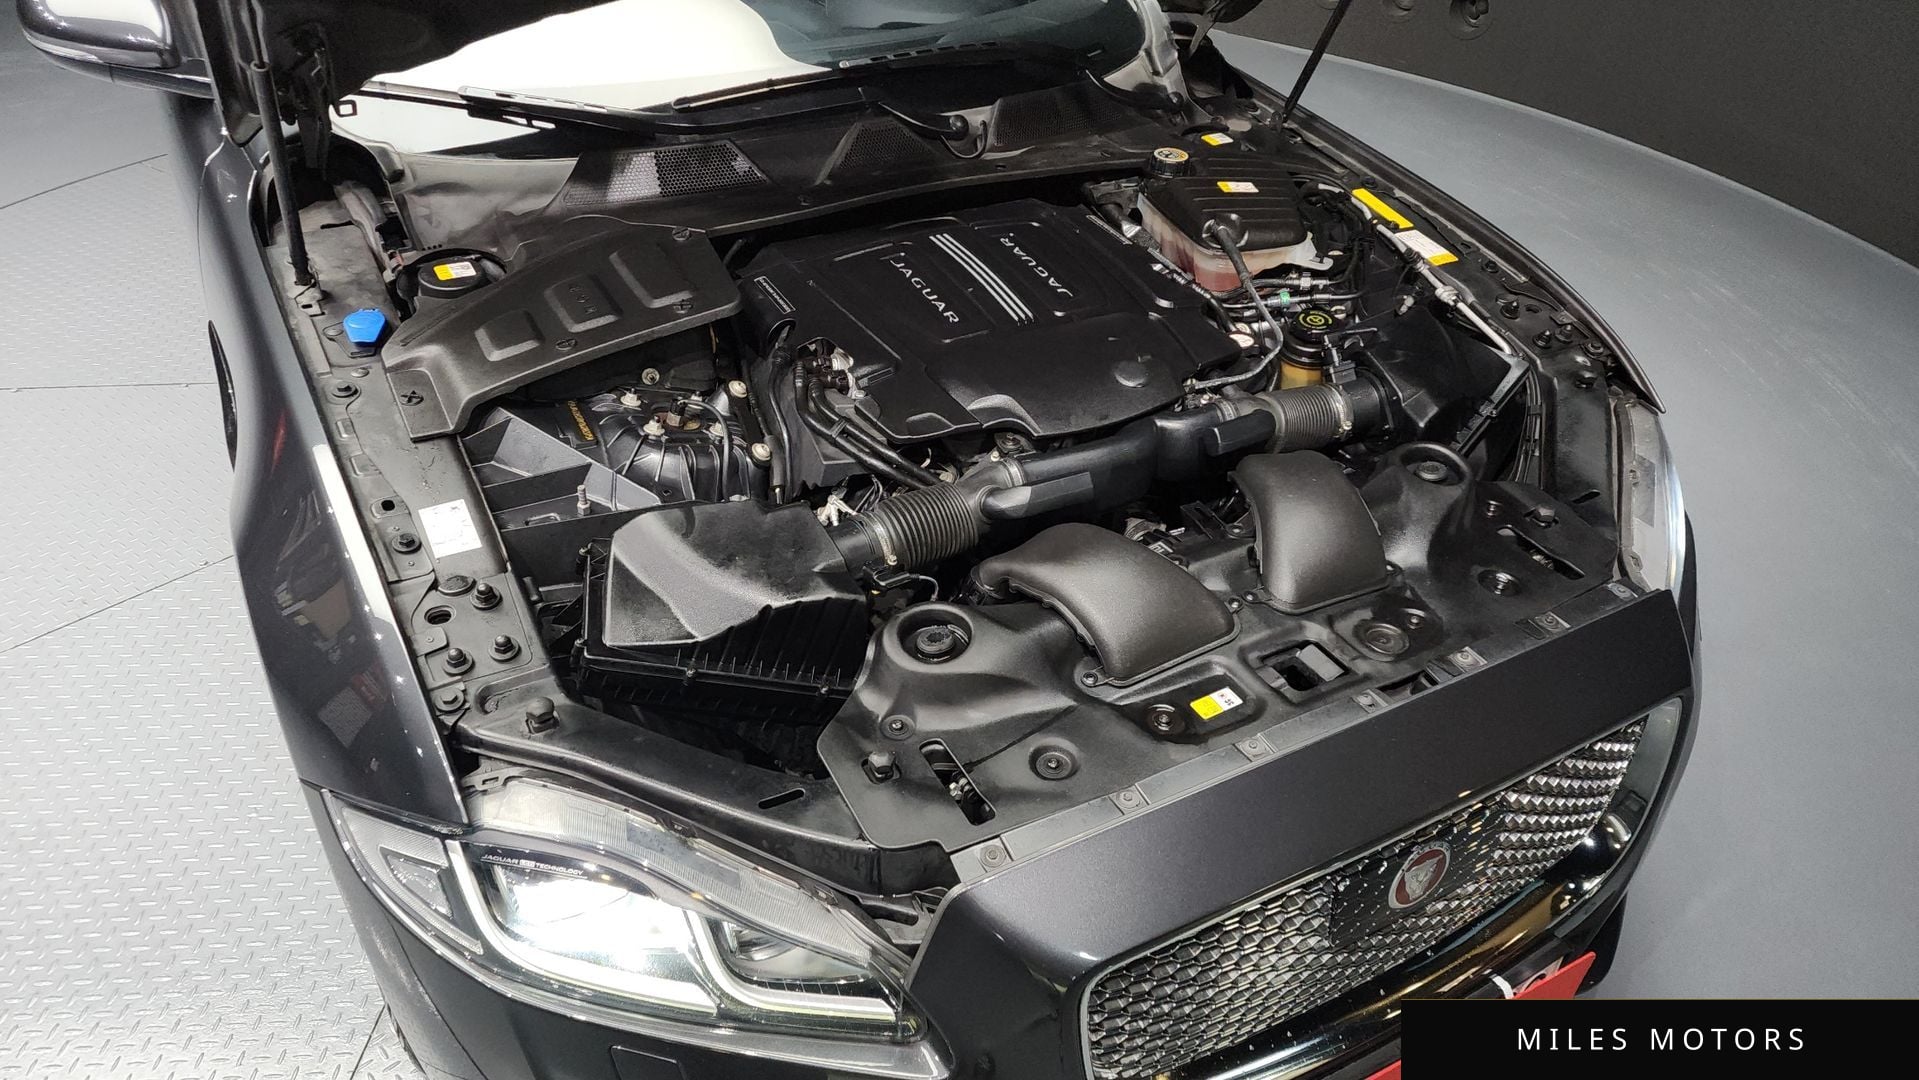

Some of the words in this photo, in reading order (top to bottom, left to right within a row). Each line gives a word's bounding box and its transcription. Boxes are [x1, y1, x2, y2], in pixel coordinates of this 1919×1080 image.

[890, 260, 959, 322] JAGUAR
[1000, 238, 1073, 297] JAGUAR
[481, 854, 519, 865] JAGUAR
[536, 862, 584, 876] TECHNOLOGY
